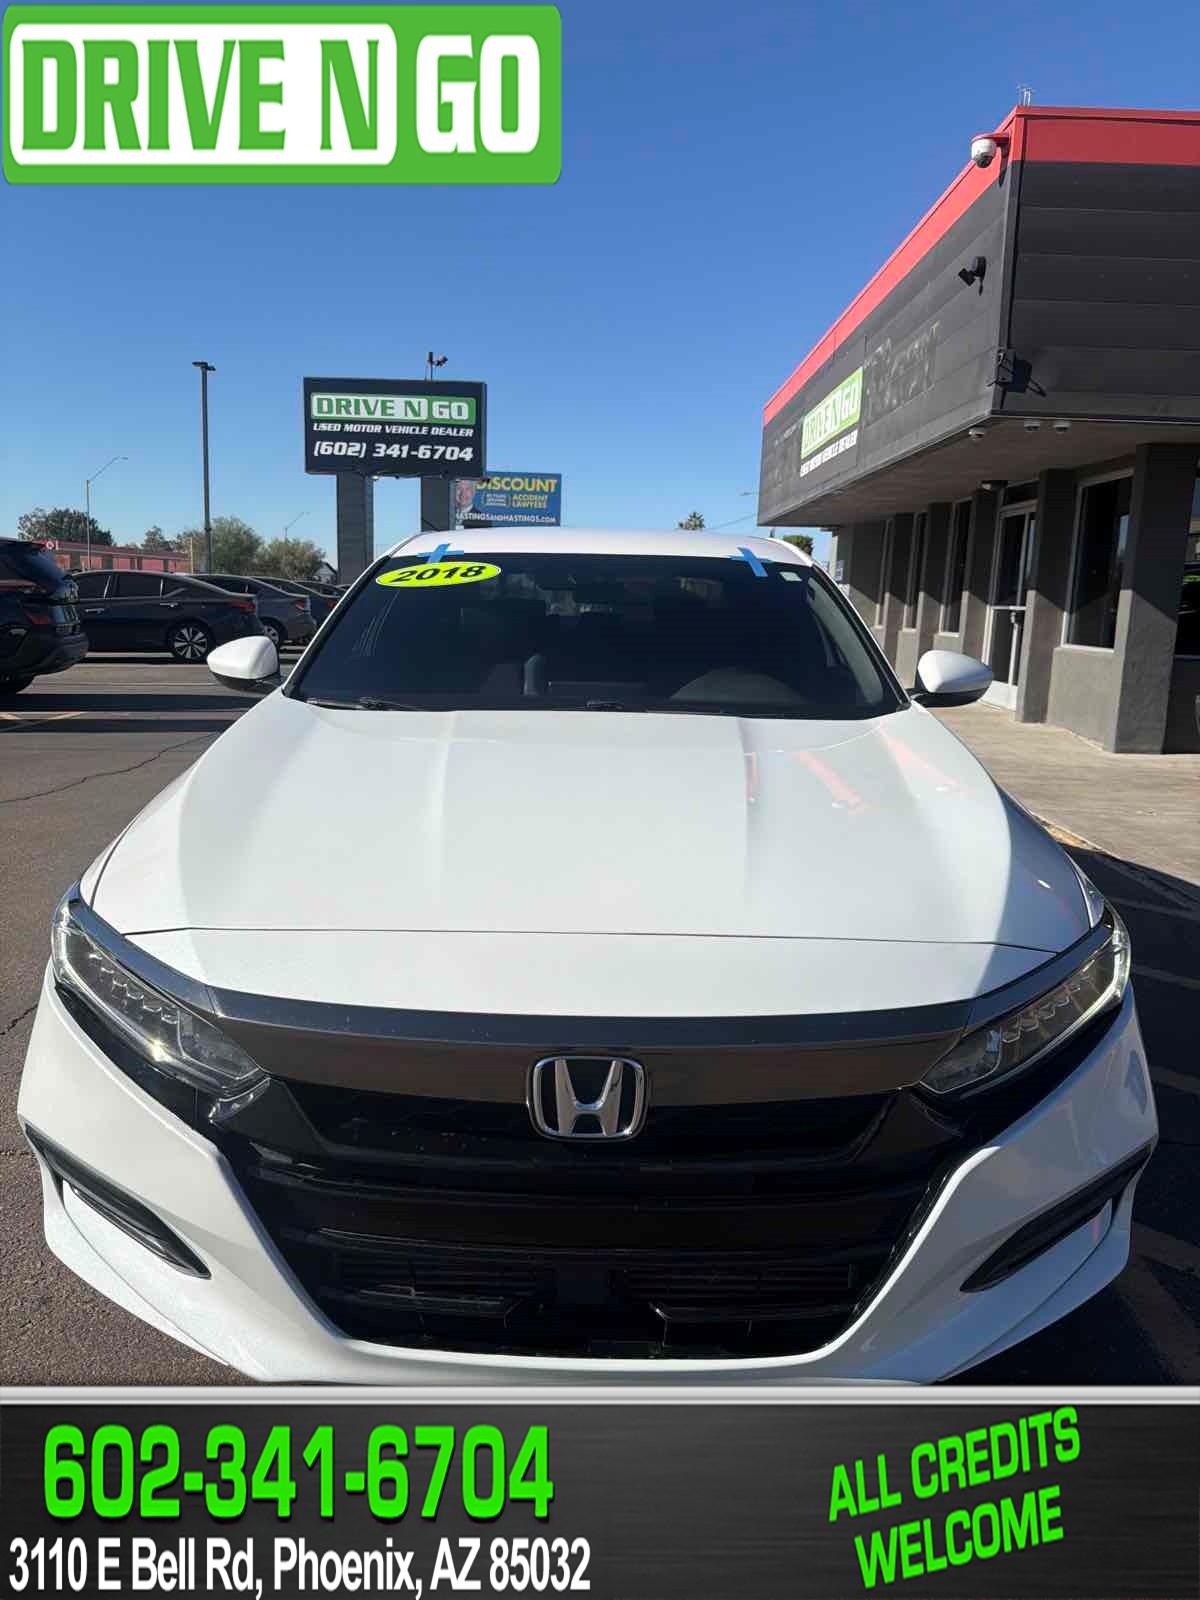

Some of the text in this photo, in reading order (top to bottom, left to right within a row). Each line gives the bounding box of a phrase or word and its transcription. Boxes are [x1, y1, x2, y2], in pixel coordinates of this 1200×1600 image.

[316, 397, 469, 420] DRIVE N GO
[313, 422, 474, 438] USED MOTOR VEHICLE DEALER
[313, 441, 474, 462] (602) 341-6704
[389, 565, 486, 583] 2018
